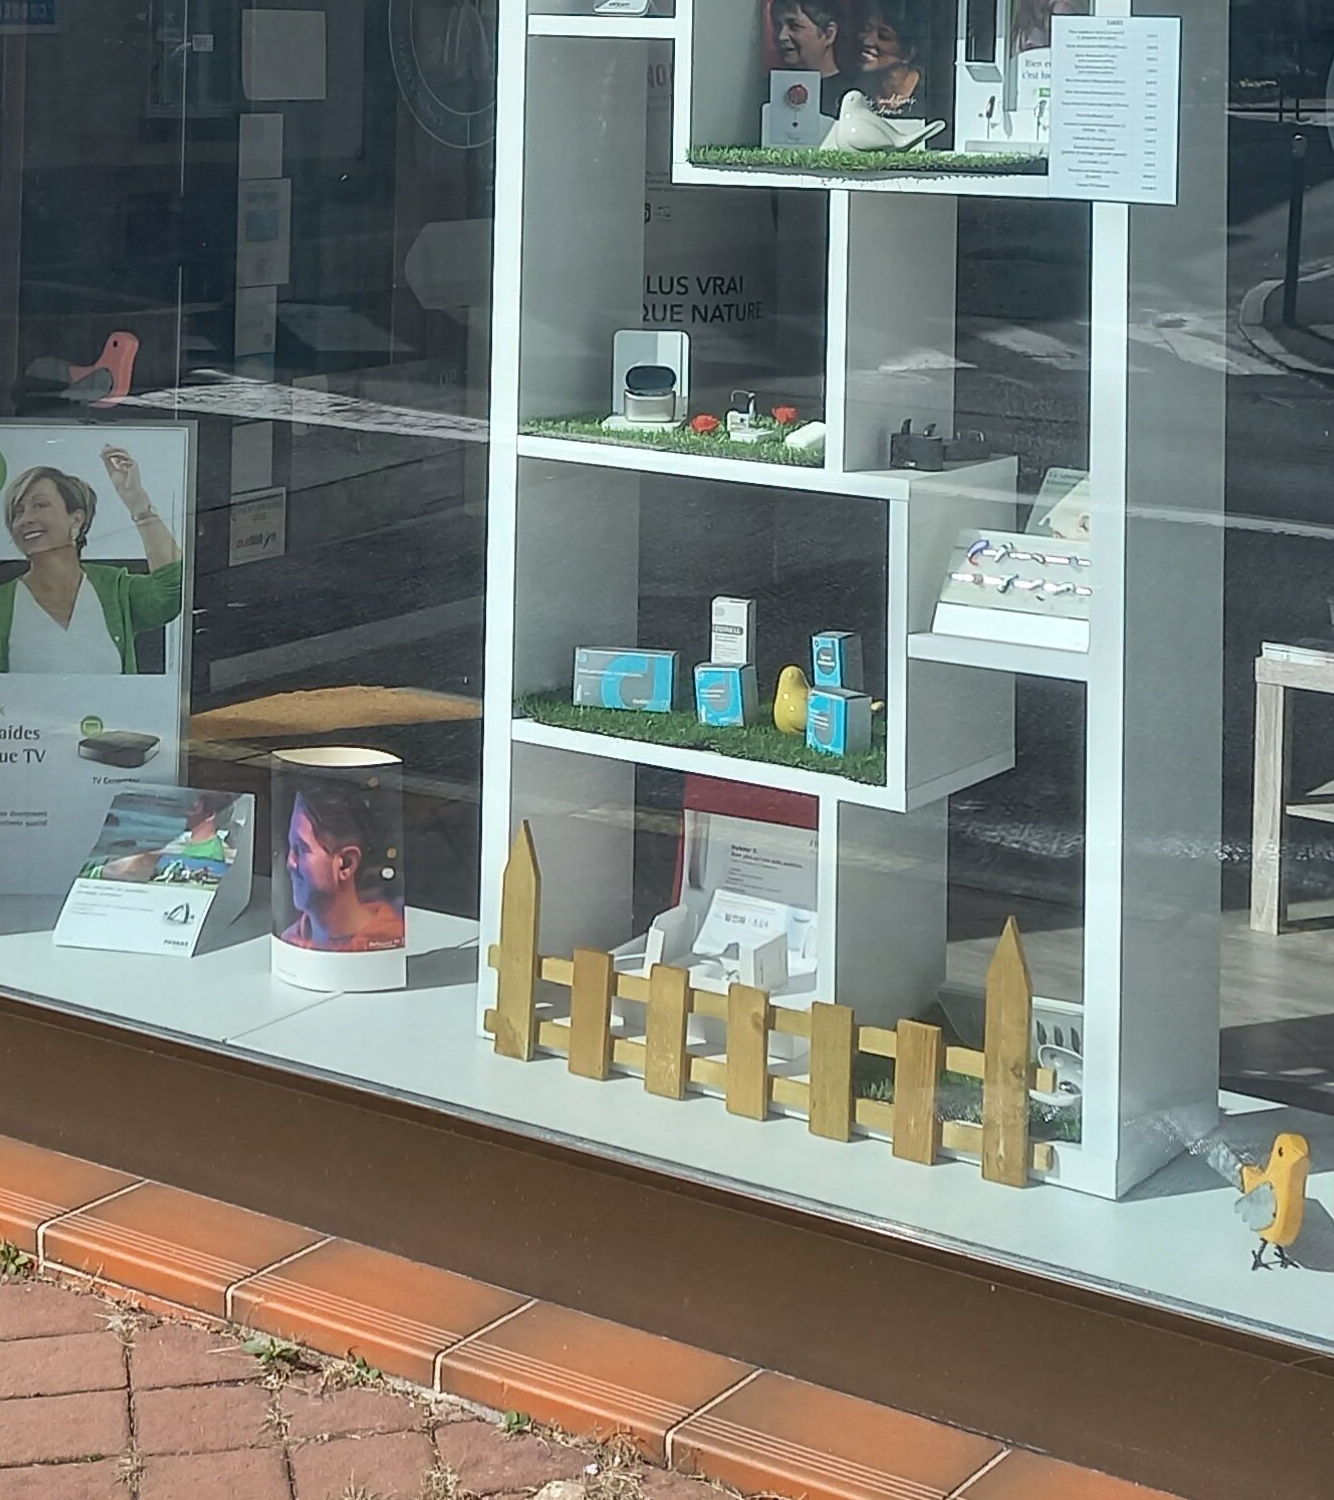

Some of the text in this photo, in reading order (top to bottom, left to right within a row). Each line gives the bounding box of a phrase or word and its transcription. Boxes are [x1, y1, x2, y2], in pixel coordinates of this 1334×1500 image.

[645, 275, 743, 296] LUS VRAI
[691, 301, 763, 323] NATURE
[23, 748, 46, 763] TV
